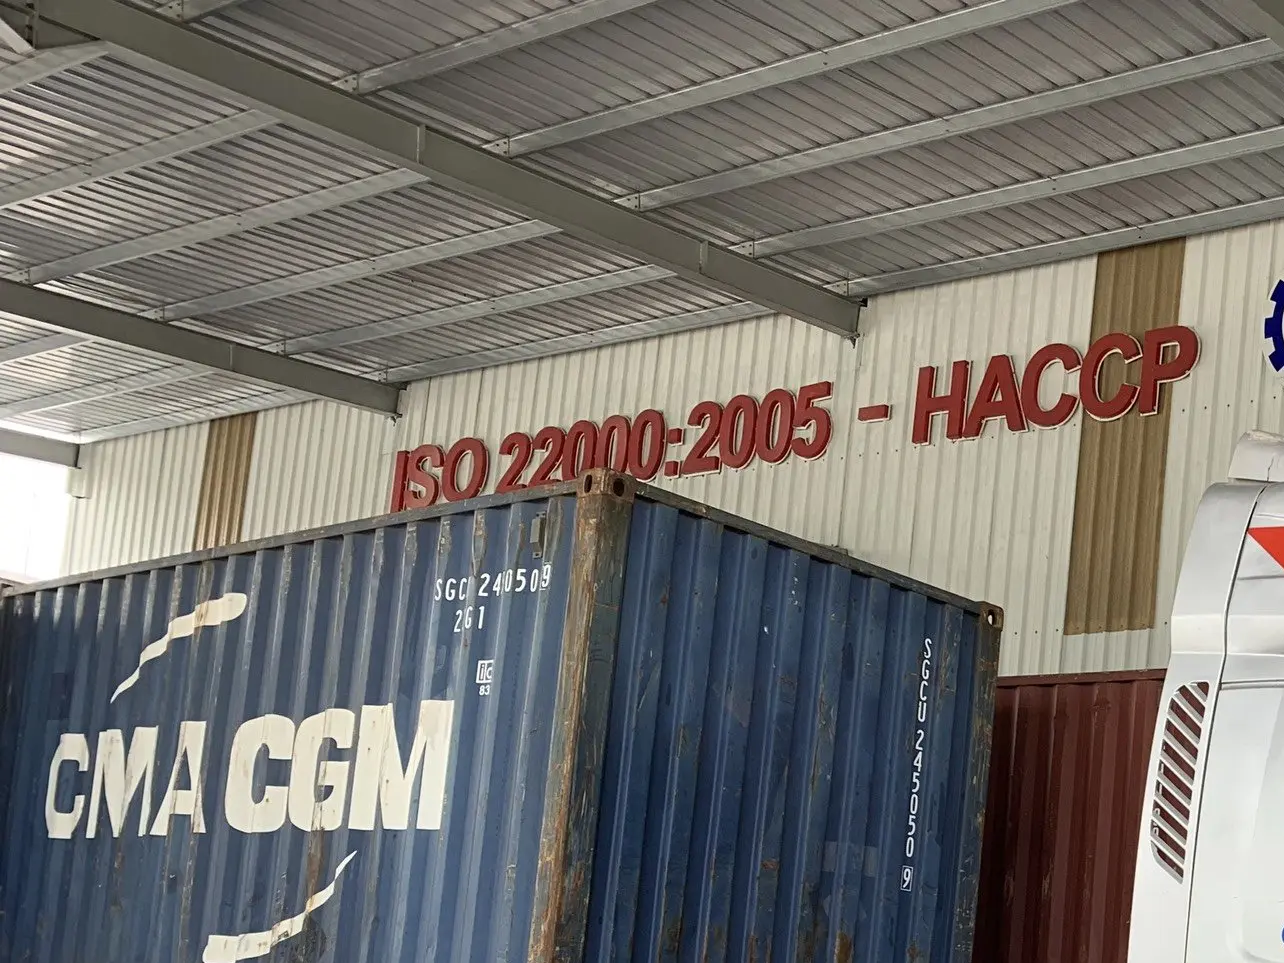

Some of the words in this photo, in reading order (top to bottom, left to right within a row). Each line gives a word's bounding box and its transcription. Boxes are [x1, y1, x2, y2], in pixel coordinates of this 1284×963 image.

[390, 437, 489, 514] ISO
[496, 381, 833, 494] 22000:2005
[912, 325, 1201, 446] HACCP
[479, 685, 490, 696] 83
[917, 638, 932, 722] SGCU
[44, 720, 206, 839] CMA
[224, 700, 454, 833] CGM
[905, 729, 925, 858] 245050
